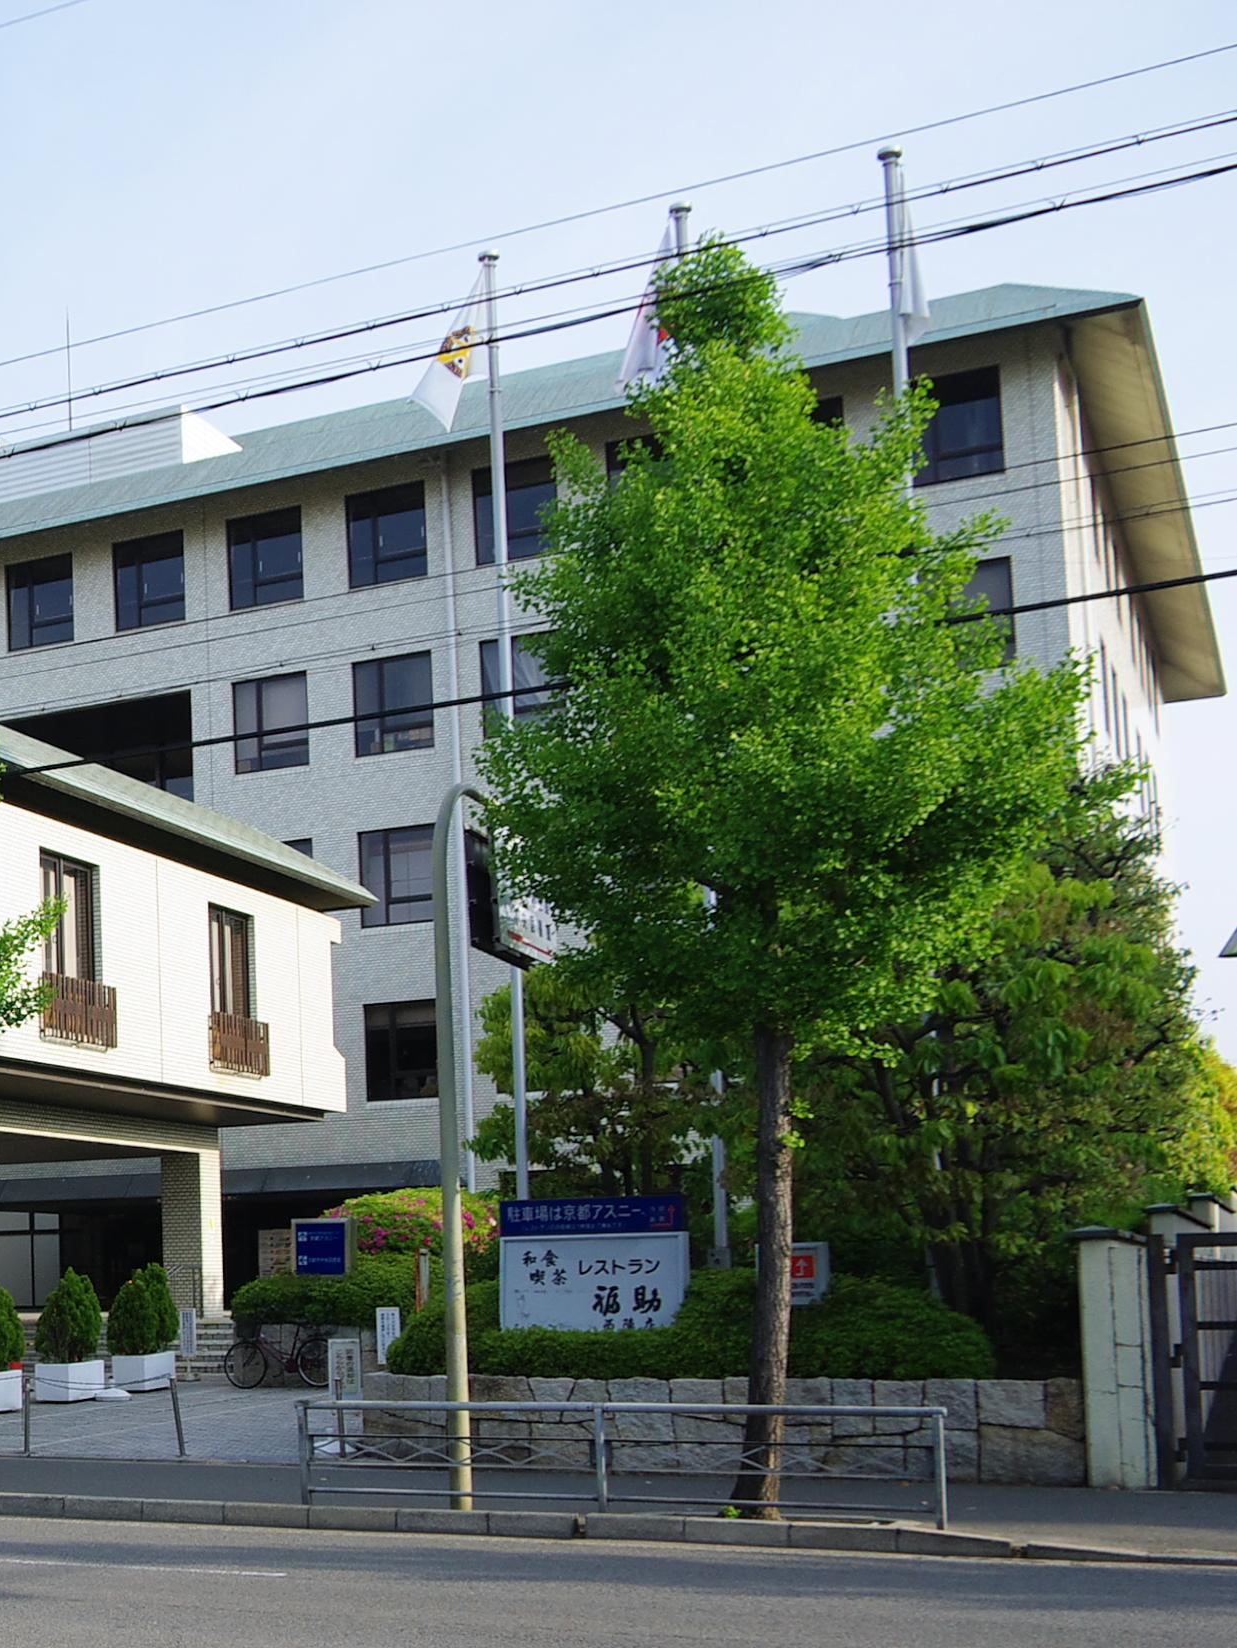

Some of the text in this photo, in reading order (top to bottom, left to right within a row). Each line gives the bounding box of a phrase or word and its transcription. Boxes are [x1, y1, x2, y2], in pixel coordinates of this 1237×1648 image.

[521, 1249, 559, 1268] 和食
[578, 1258, 660, 1276] レストラン
[529, 1269, 568, 1286] 喫茶
